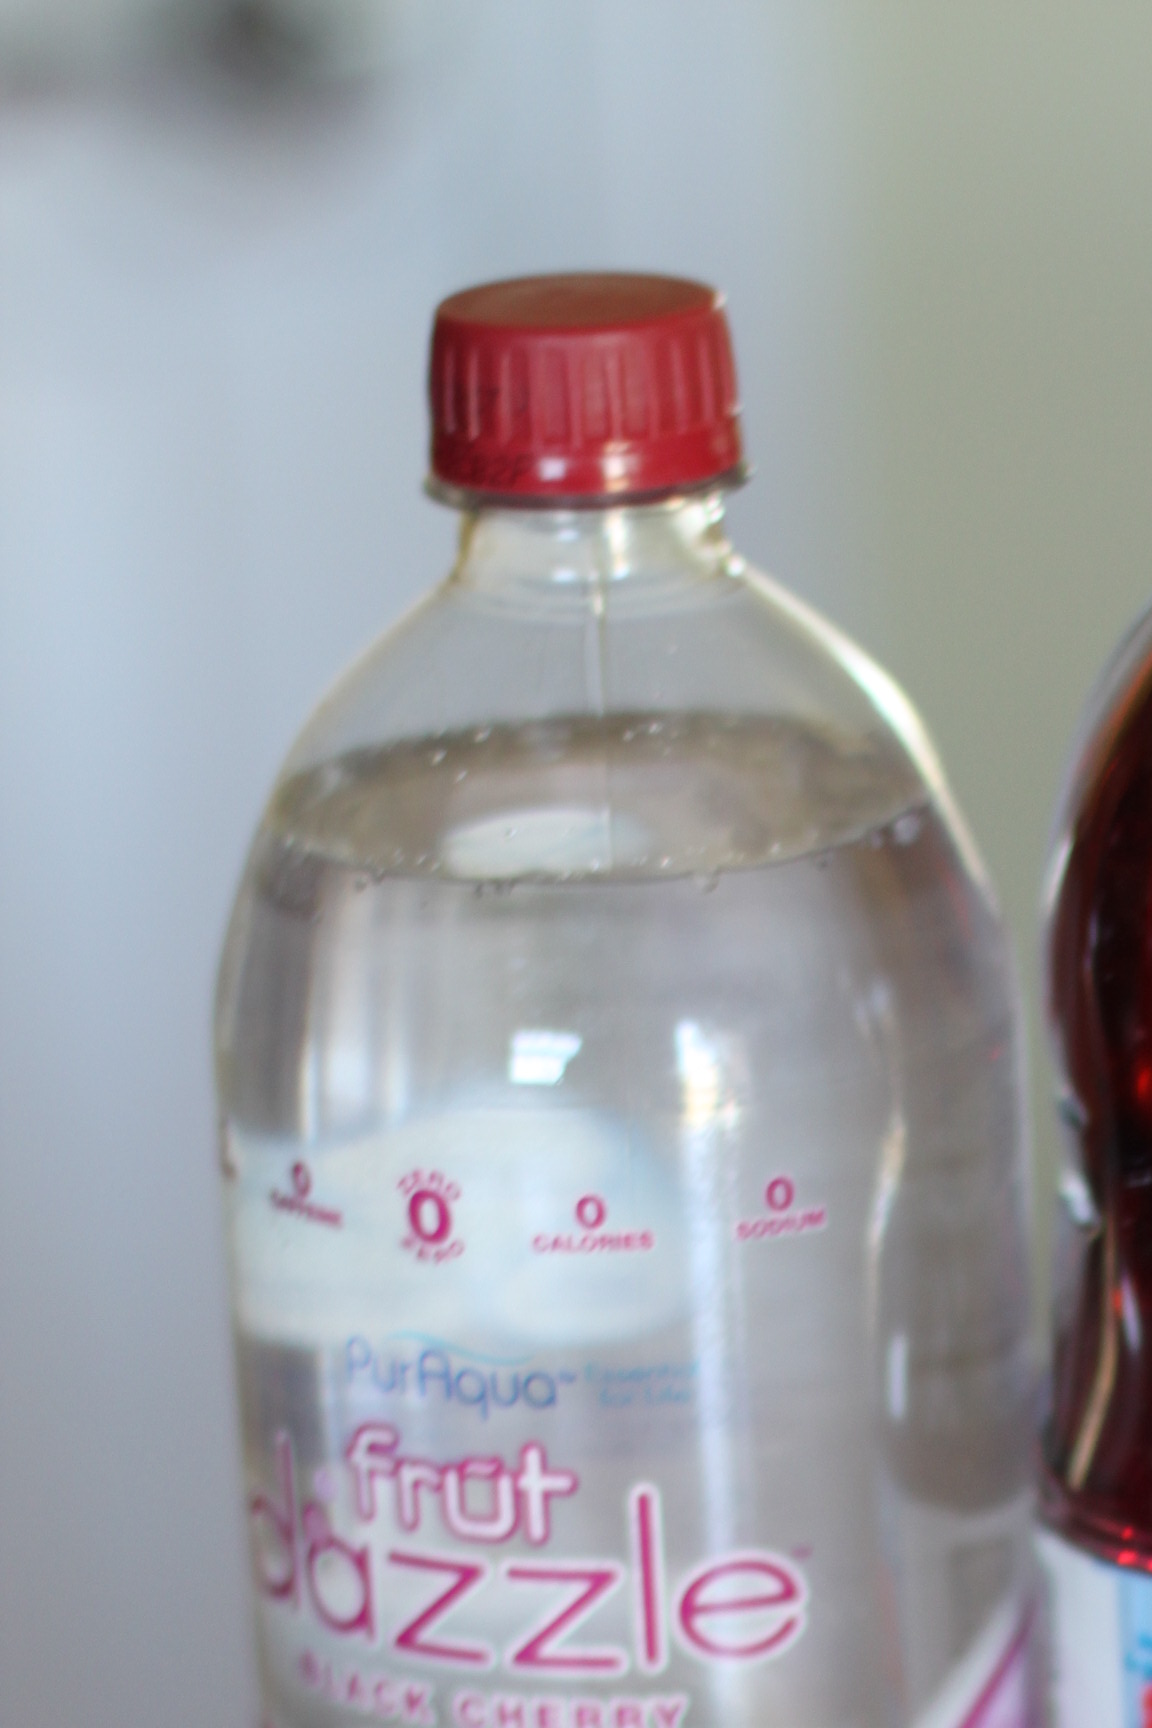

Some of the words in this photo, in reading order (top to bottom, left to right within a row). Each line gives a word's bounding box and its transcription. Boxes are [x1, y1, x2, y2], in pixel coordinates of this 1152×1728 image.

[408, 1189, 451, 1245] 0
[531, 1229, 656, 1254] CALORIES
[251, 1428, 808, 1675] dazzle
